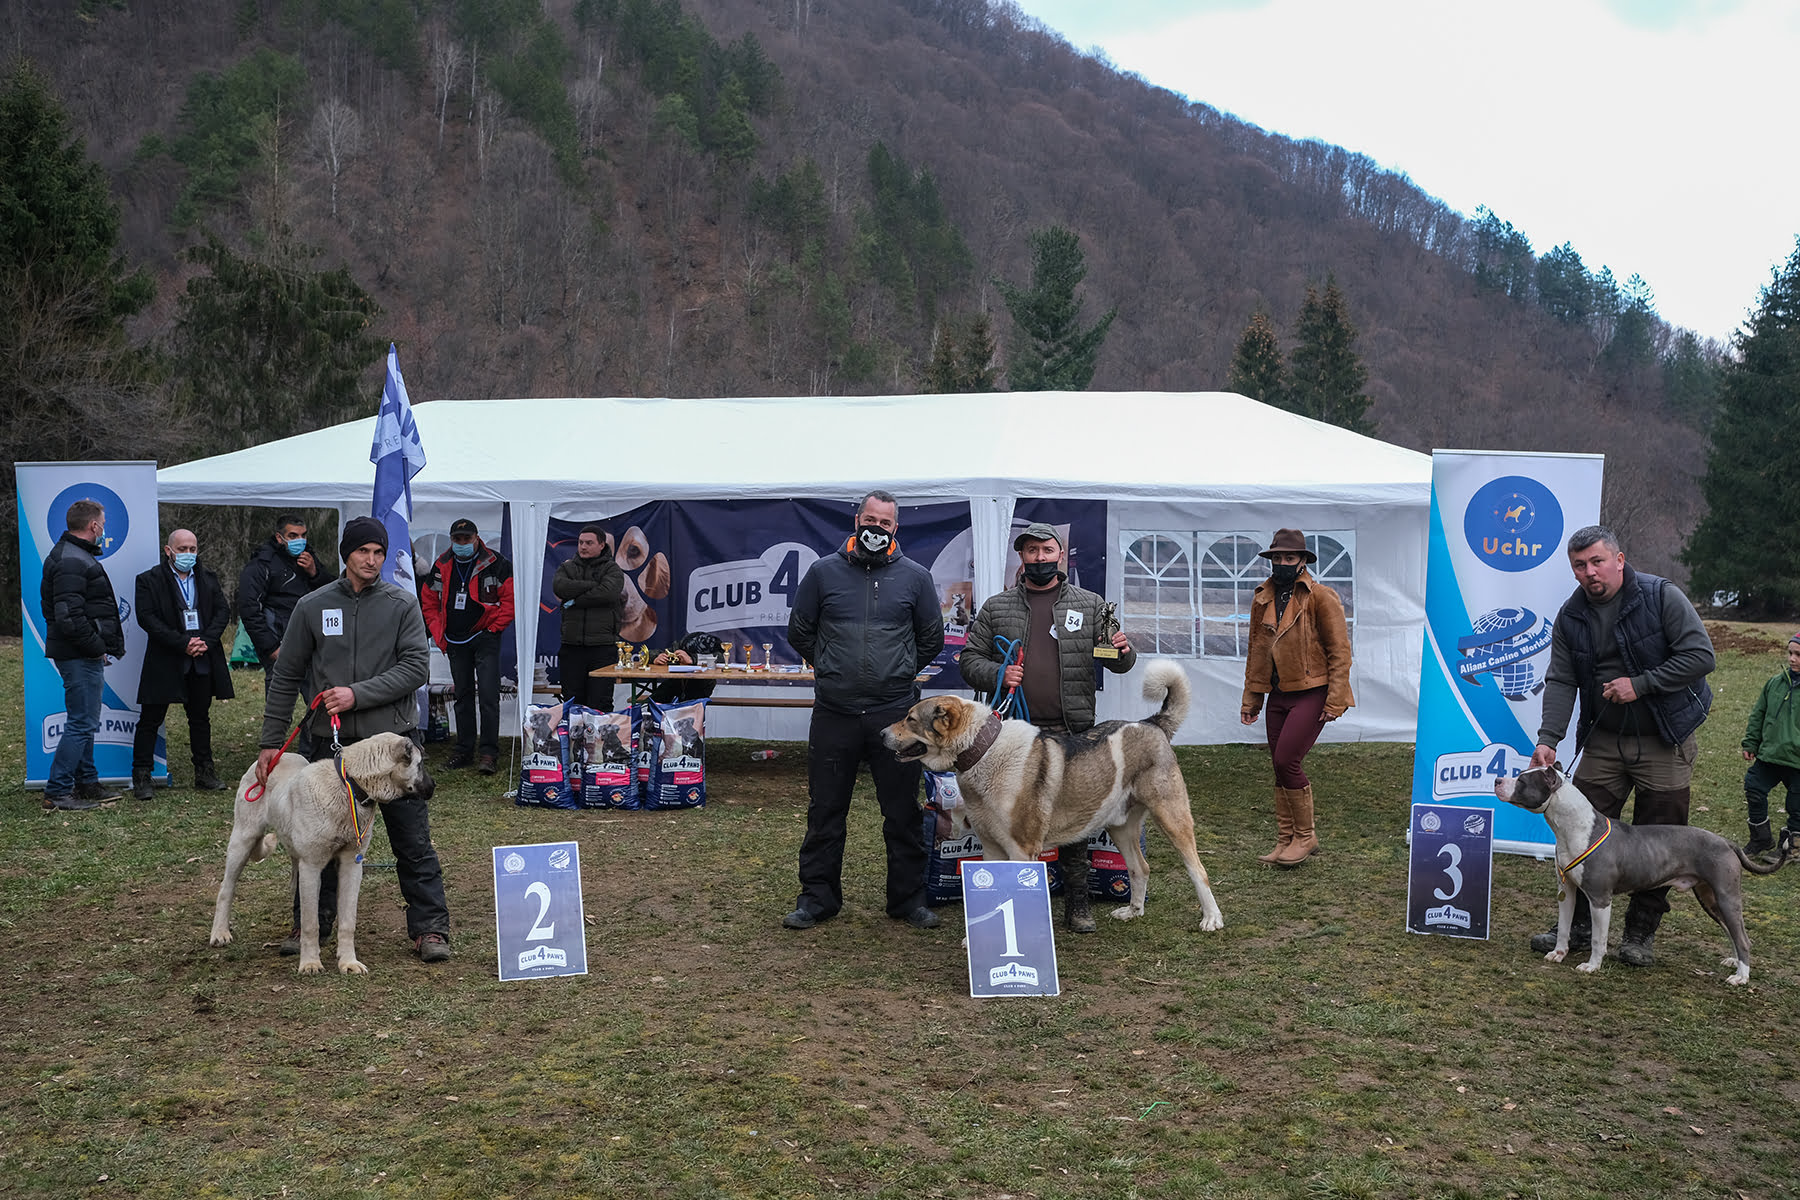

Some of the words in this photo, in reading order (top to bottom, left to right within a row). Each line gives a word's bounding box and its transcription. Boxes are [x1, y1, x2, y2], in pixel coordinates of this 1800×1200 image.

[1483, 537, 1542, 556] Uchr
[694, 581, 762, 612] CLUB
[769, 550, 799, 608] 4
[326, 617, 339, 628] 118
[760, 612, 791, 621] PREM
[1068, 616, 1080, 627] 54
[1460, 661, 1487, 674] Alianz
[106, 720, 136, 733] PAW
[532, 754, 539, 766] 4
[641, 753, 648, 764] 4
[679, 756, 686, 768] 4
[1440, 765, 1482, 781] CLUB
[1486, 749, 1507, 779] 4
[572, 764, 579, 775] 4
[1098, 830, 1107, 846] 4
[942, 845, 962, 854] CLUB
[963, 837, 972, 852] 4
[1433, 843, 1463, 900] 3
[524, 881, 555, 940] 2
[1444, 907, 1451, 919] 4
[1452, 913, 1468, 922] PAWS
[995, 898, 1025, 956] 1
[521, 955, 537, 963] CLUB
[538, 947, 545, 960] 4
[1009, 964, 1017, 977] 4
